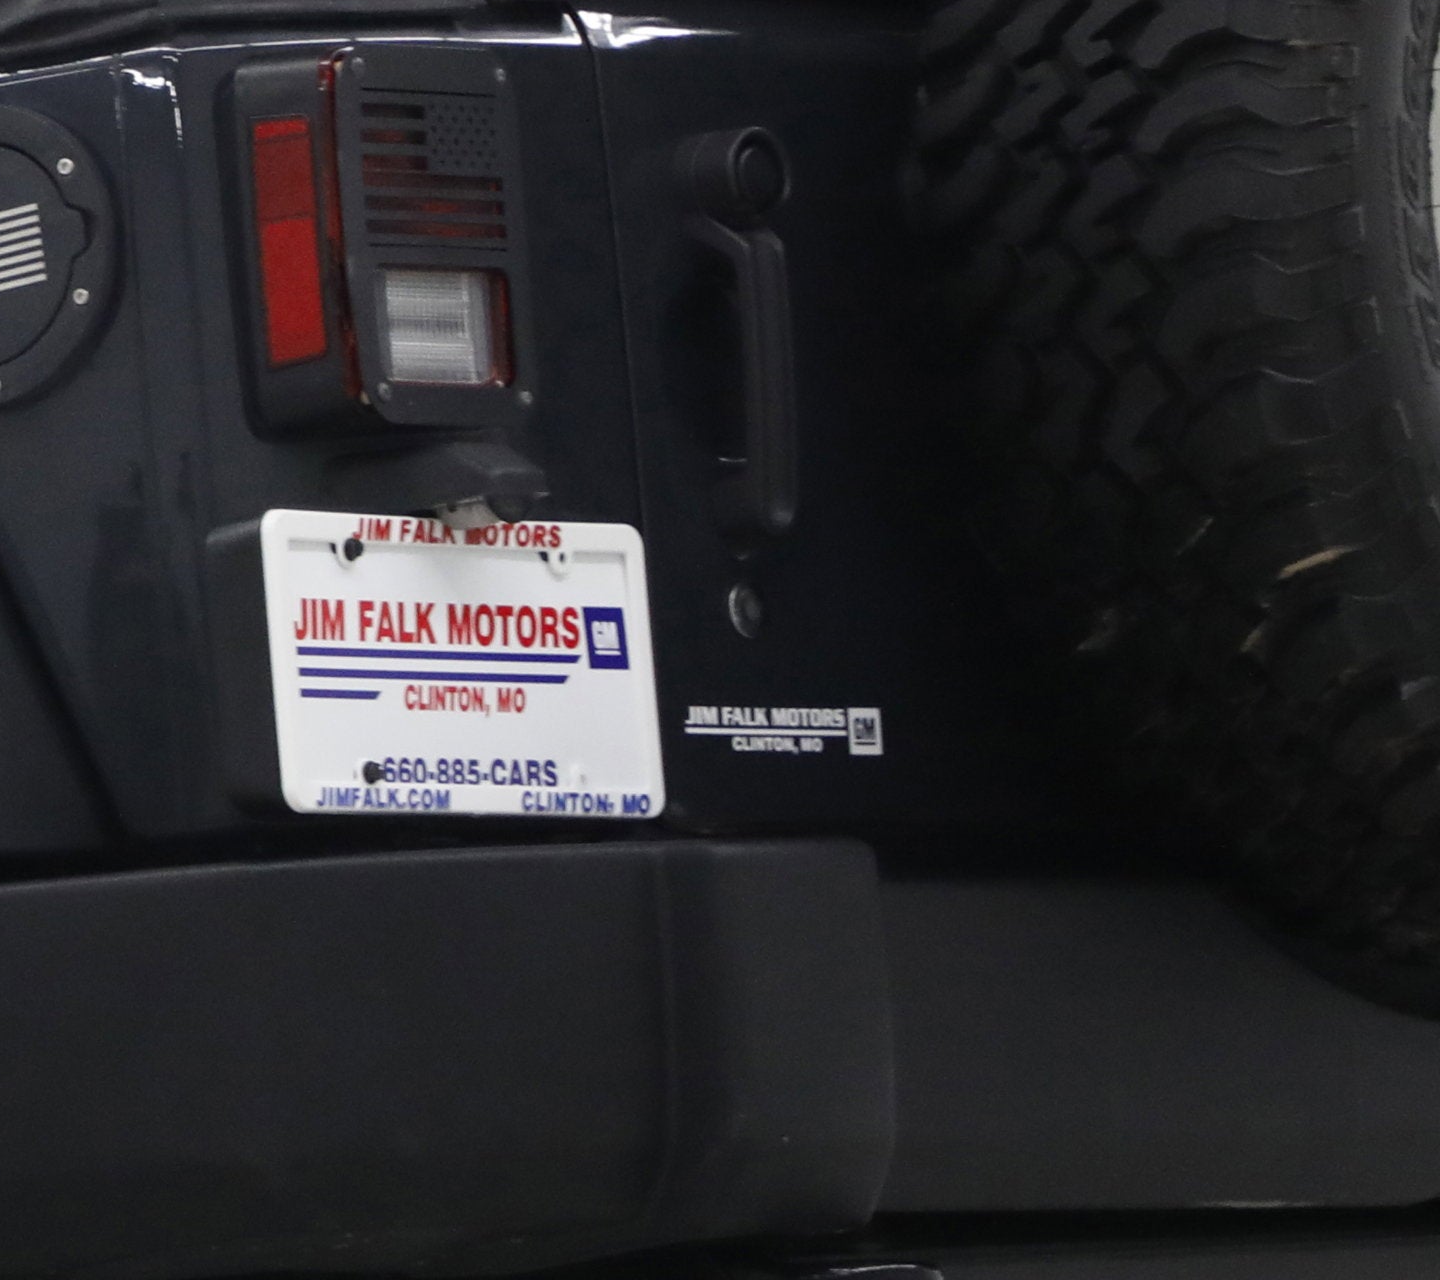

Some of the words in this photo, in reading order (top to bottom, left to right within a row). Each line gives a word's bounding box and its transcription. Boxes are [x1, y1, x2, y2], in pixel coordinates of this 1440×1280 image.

[353, 518, 391, 540] JIM
[399, 521, 455, 545] FALK
[464, 523, 561, 548] MOTORS
[294, 598, 344, 641] JIM
[357, 600, 436, 644] FALK
[447, 603, 580, 649] MOTORS
[404, 685, 491, 717] CLINTON,
[497, 688, 526, 713] MO
[685, 706, 718, 725] JIM
[722, 706, 768, 726] FALK
[771, 707, 846, 727] MOTORS
[732, 736, 799, 754] CLINTON,
[800, 738, 823, 752] MO
[382, 757, 557, 787] 660-885-CARS
[317, 787, 451, 810] JIMFALK.COM
[622, 793, 651, 814] MO
